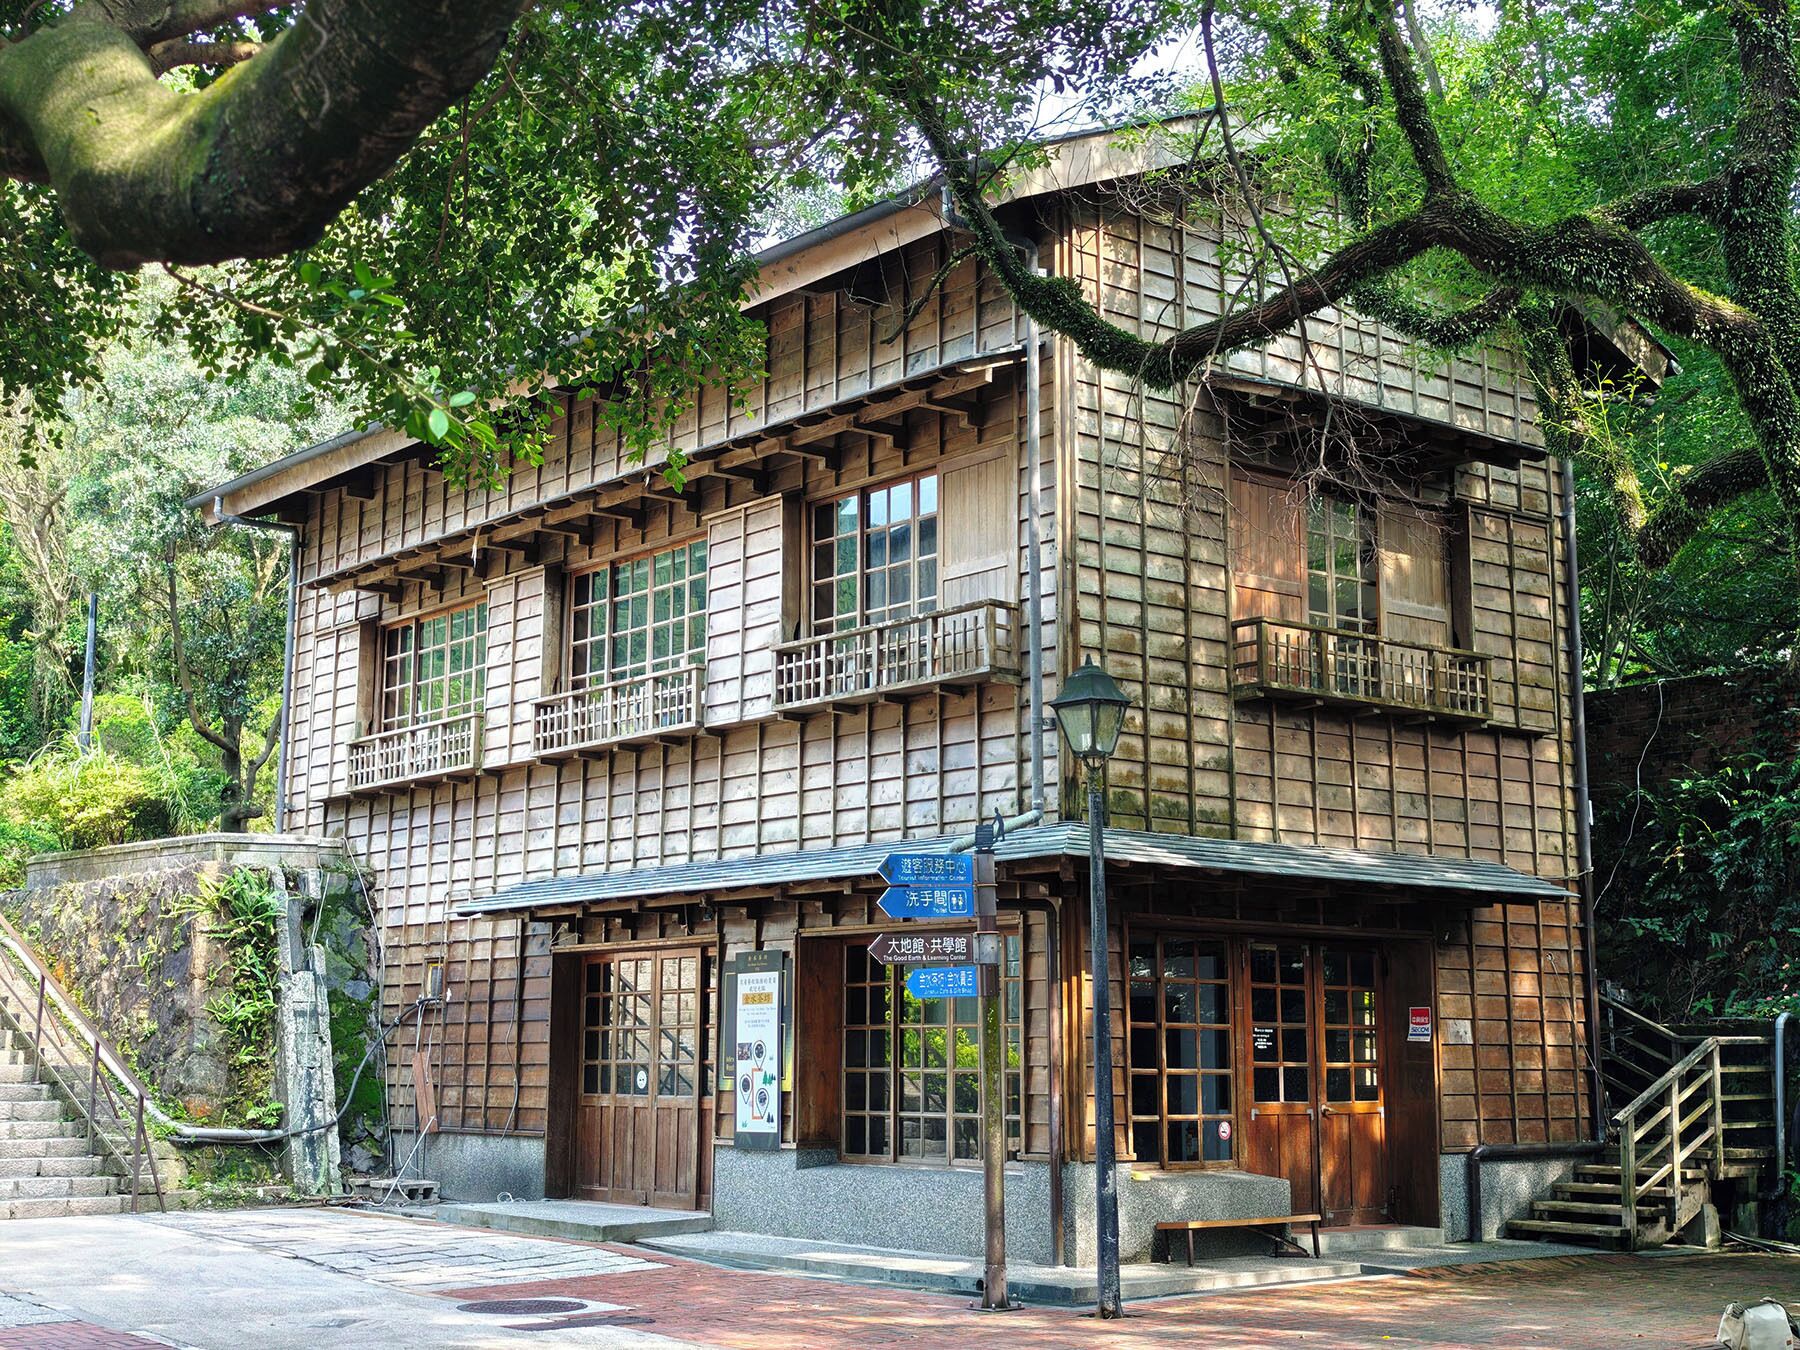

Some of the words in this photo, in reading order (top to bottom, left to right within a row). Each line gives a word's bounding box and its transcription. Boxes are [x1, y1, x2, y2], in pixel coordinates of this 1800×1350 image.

[901, 858, 967, 874] 遊客服務中心
[906, 890, 947, 907] 洗手間
[887, 937, 967, 954] 大地館、共學館
[927, 954, 949, 962] Learning
